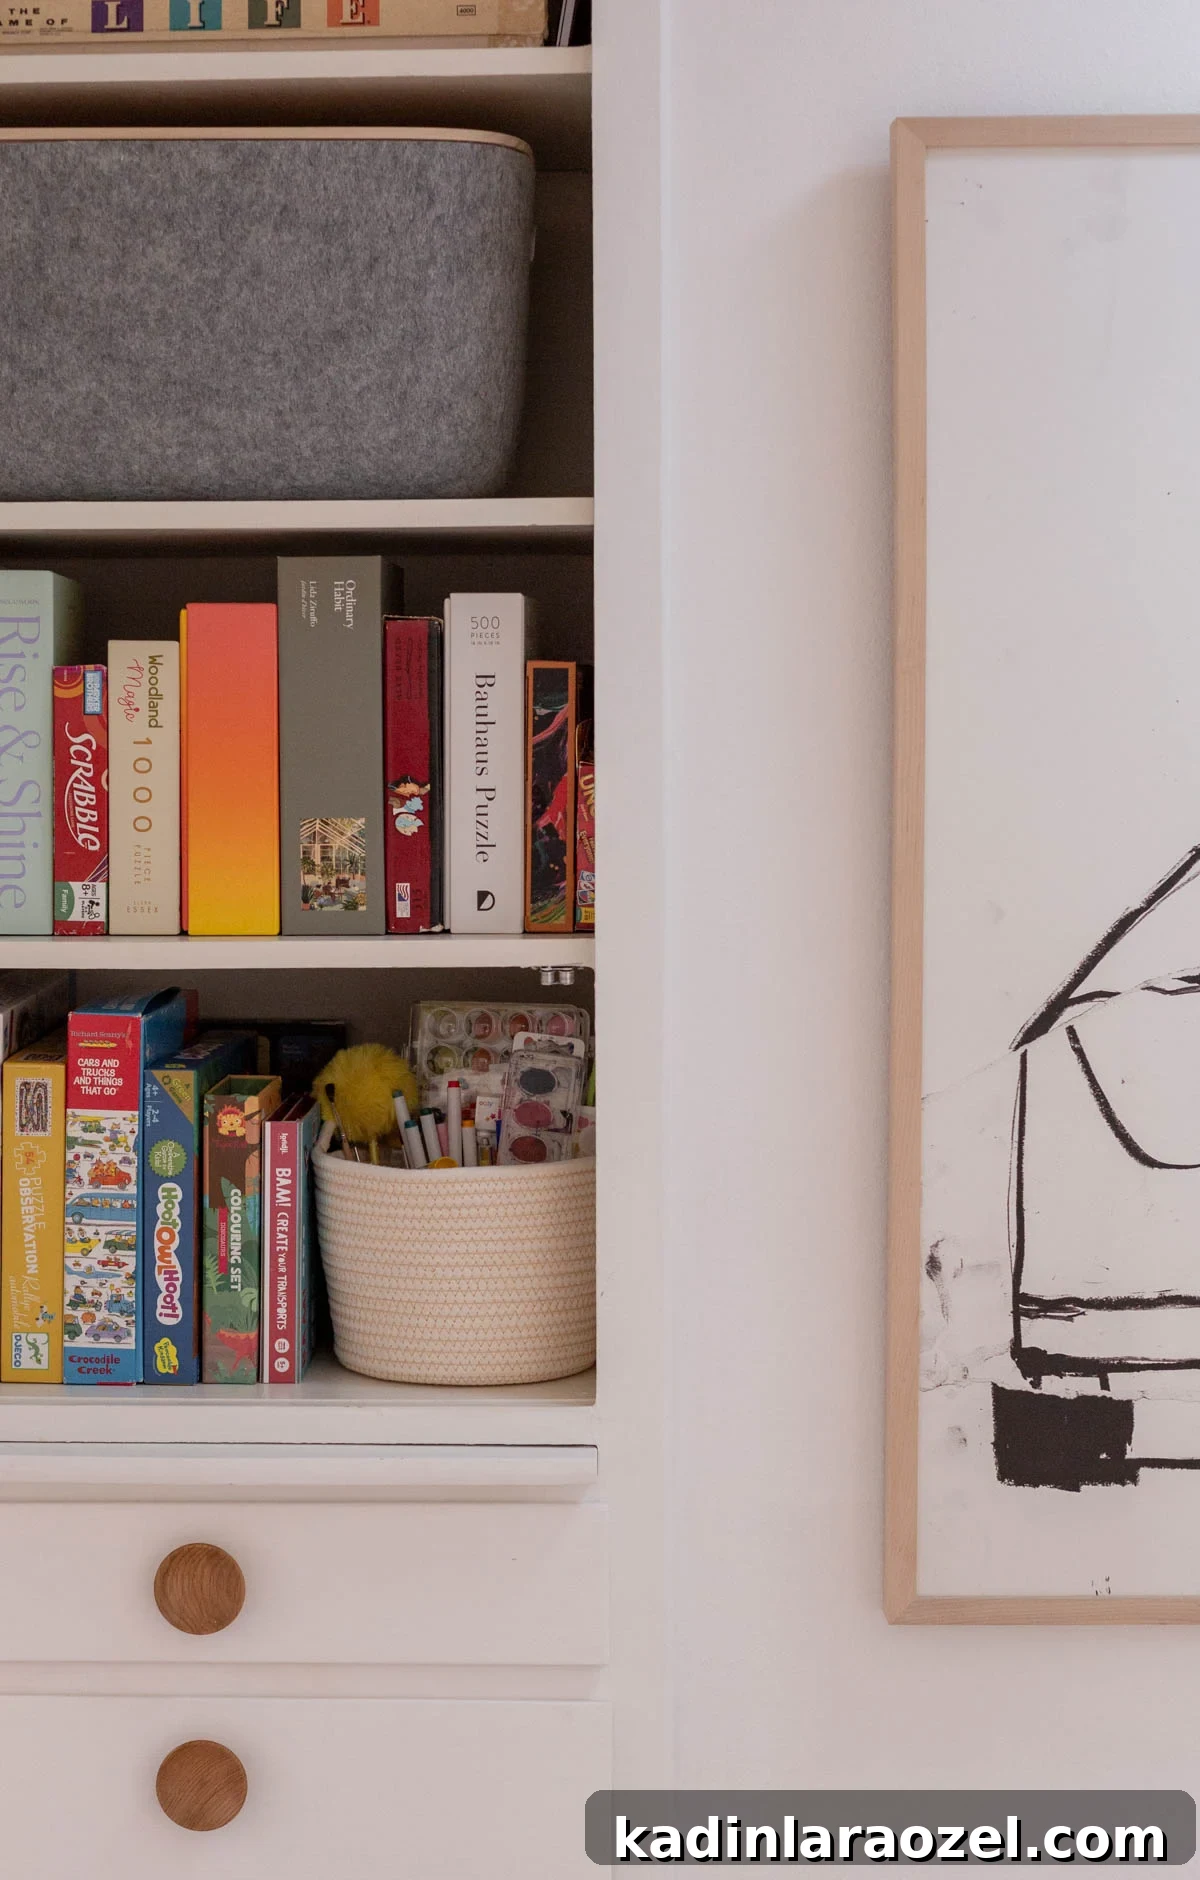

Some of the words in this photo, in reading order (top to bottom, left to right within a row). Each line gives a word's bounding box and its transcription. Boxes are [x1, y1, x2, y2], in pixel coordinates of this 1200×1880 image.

[46, 18, 69, 26] OF
[334, 581, 345, 612] Habit
[343, 579, 357, 630] Ordinary
[470, 616, 500, 629] 500
[0, 616, 40, 712] Rise
[117, 658, 145, 722] Magic
[148, 655, 163, 728] Woodland
[475, 672, 497, 776] Bauhaus
[0, 724, 41, 766] &
[133, 737, 153, 832] 1000
[475, 785, 497, 863] Puzzle
[0, 780, 42, 908] Shine
[61, 889, 69, 913] Family
[81, 884, 90, 896] 8+
[73, 1076, 92, 1085] AND
[93, 1077, 123, 1086] THINGS
[77, 1058, 100, 1067] CARS
[100, 1058, 120, 1067] AND
[81, 1067, 115, 1077] TRUCKS
[80, 1086, 103, 1094] THAT
[103, 1087, 117, 1096] GO
[24, 1151, 36, 1165] 54
[31, 1177, 46, 1230] PUZZLE
[275, 1167, 291, 1207] BAM!
[19, 1177, 39, 1274] OBSERVATION
[230, 1188, 242, 1264] COLOURING
[276, 1212, 289, 1252] CREATE
[230, 1266, 242, 1292] SET
[278, 1252, 287, 1273] YOUR
[276, 1274, 288, 1330] TRANSPORTS
[14, 1334, 22, 1368] DJECO
[68, 1353, 121, 1364] Crocodile
[77, 1364, 112, 1375] Creek
